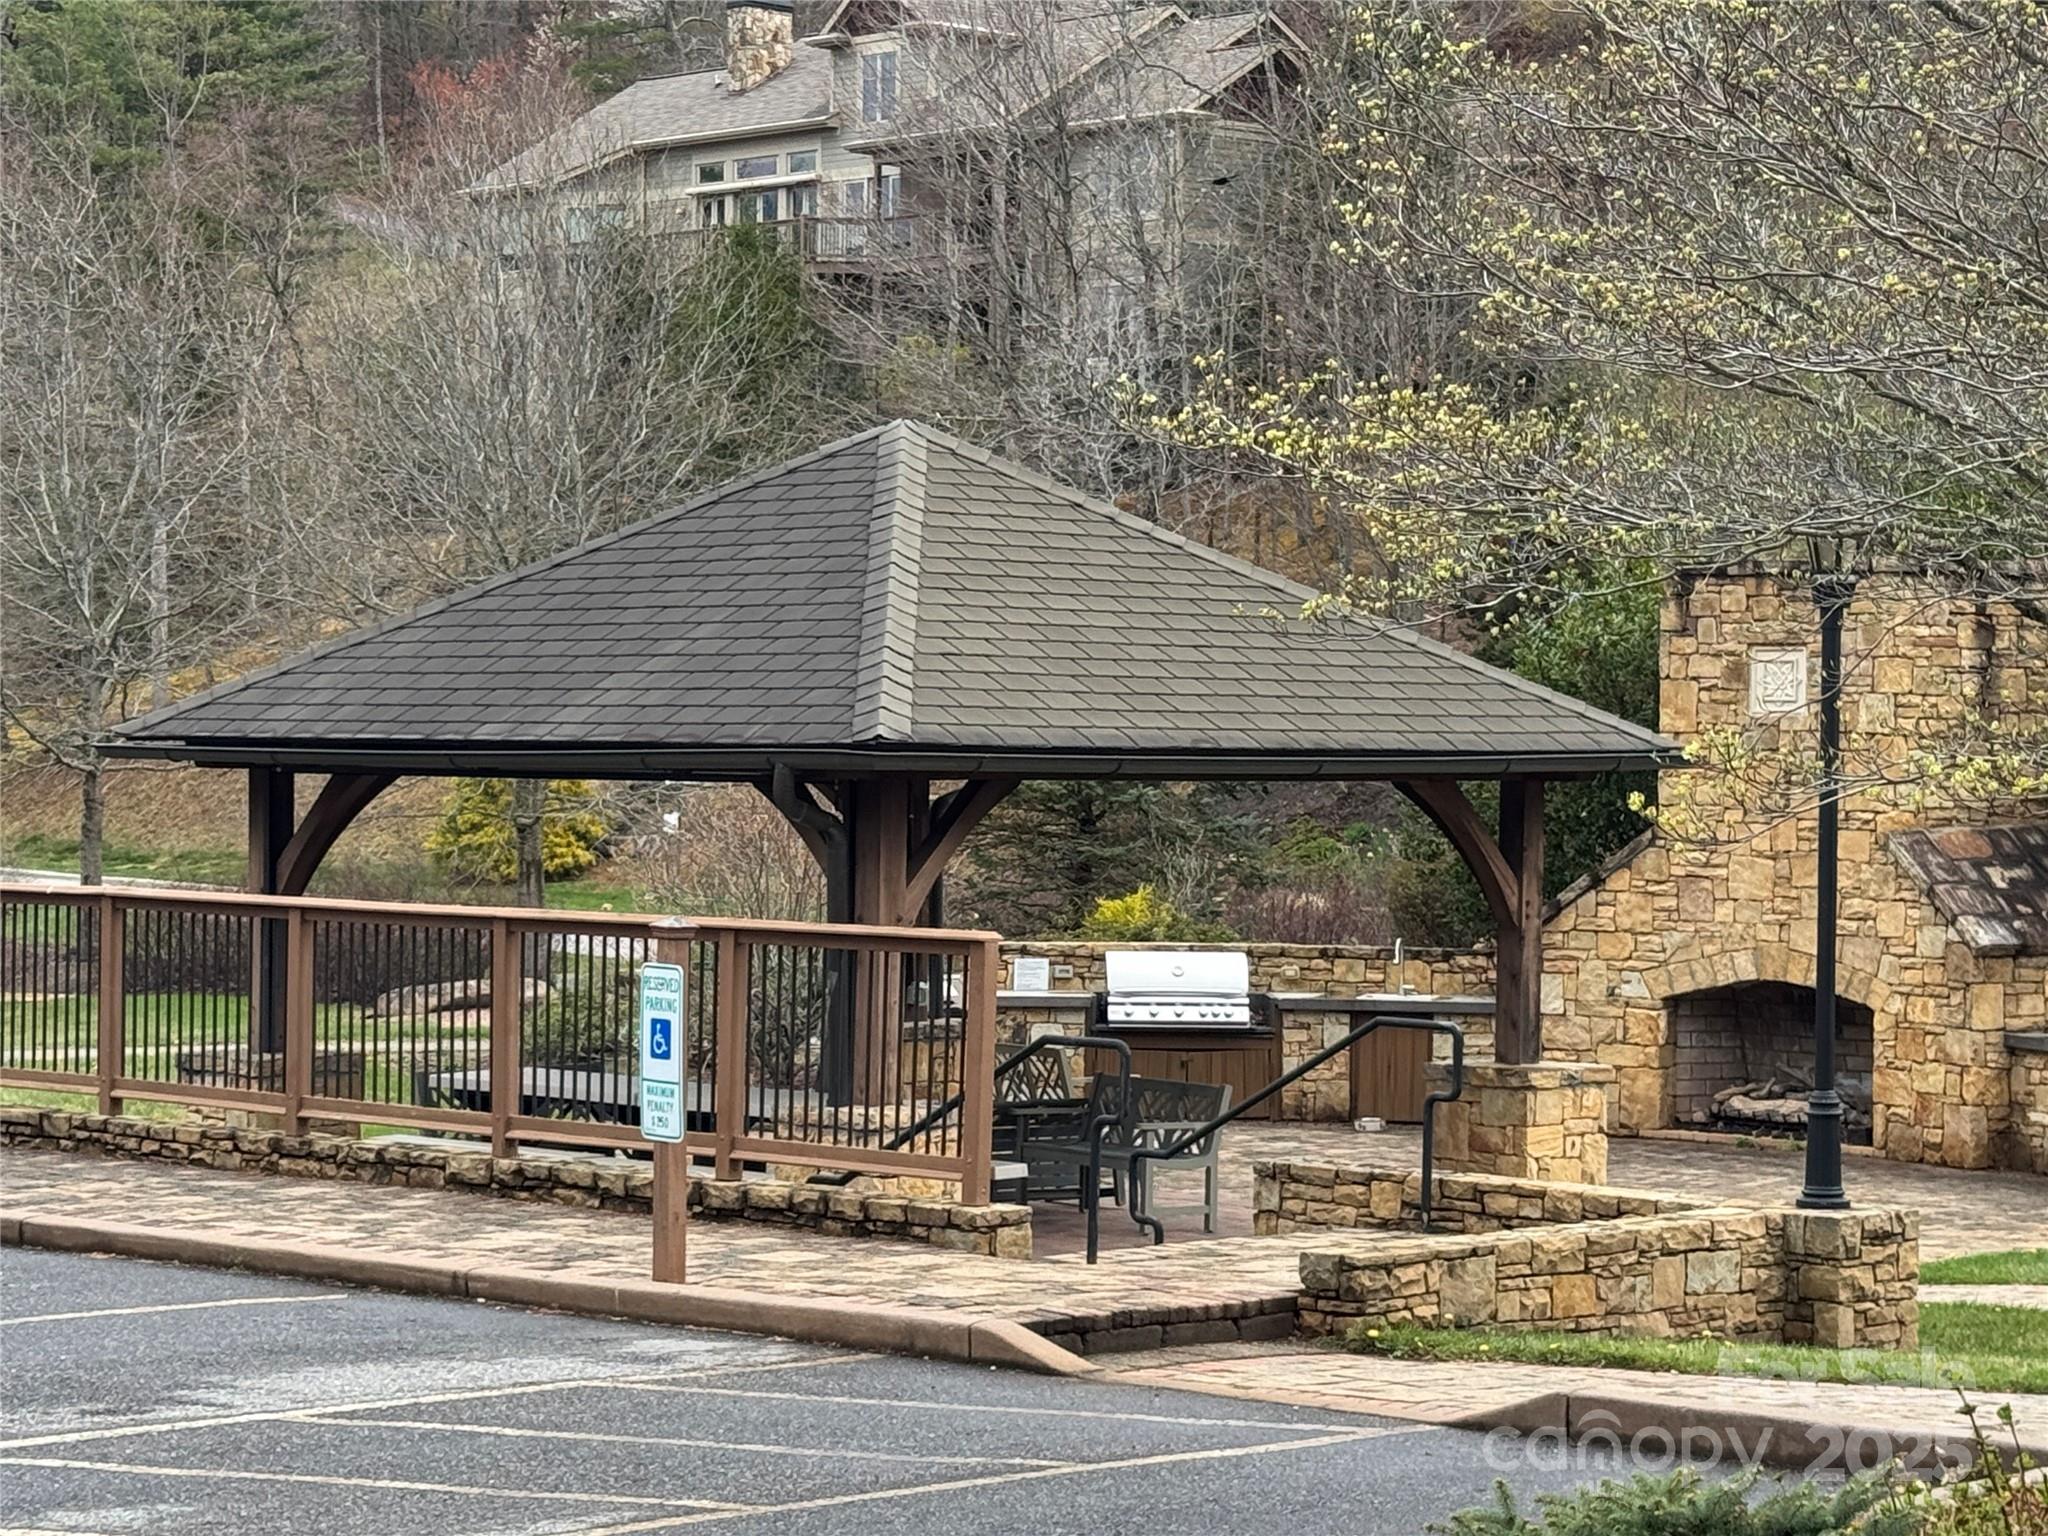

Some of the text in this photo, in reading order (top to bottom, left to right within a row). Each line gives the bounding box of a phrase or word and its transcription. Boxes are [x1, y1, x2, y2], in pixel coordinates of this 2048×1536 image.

[645, 995, 677, 1013] PARKING
[646, 1085, 675, 1098] MAXIMUM
[647, 1099, 674, 1113] PENALTY
